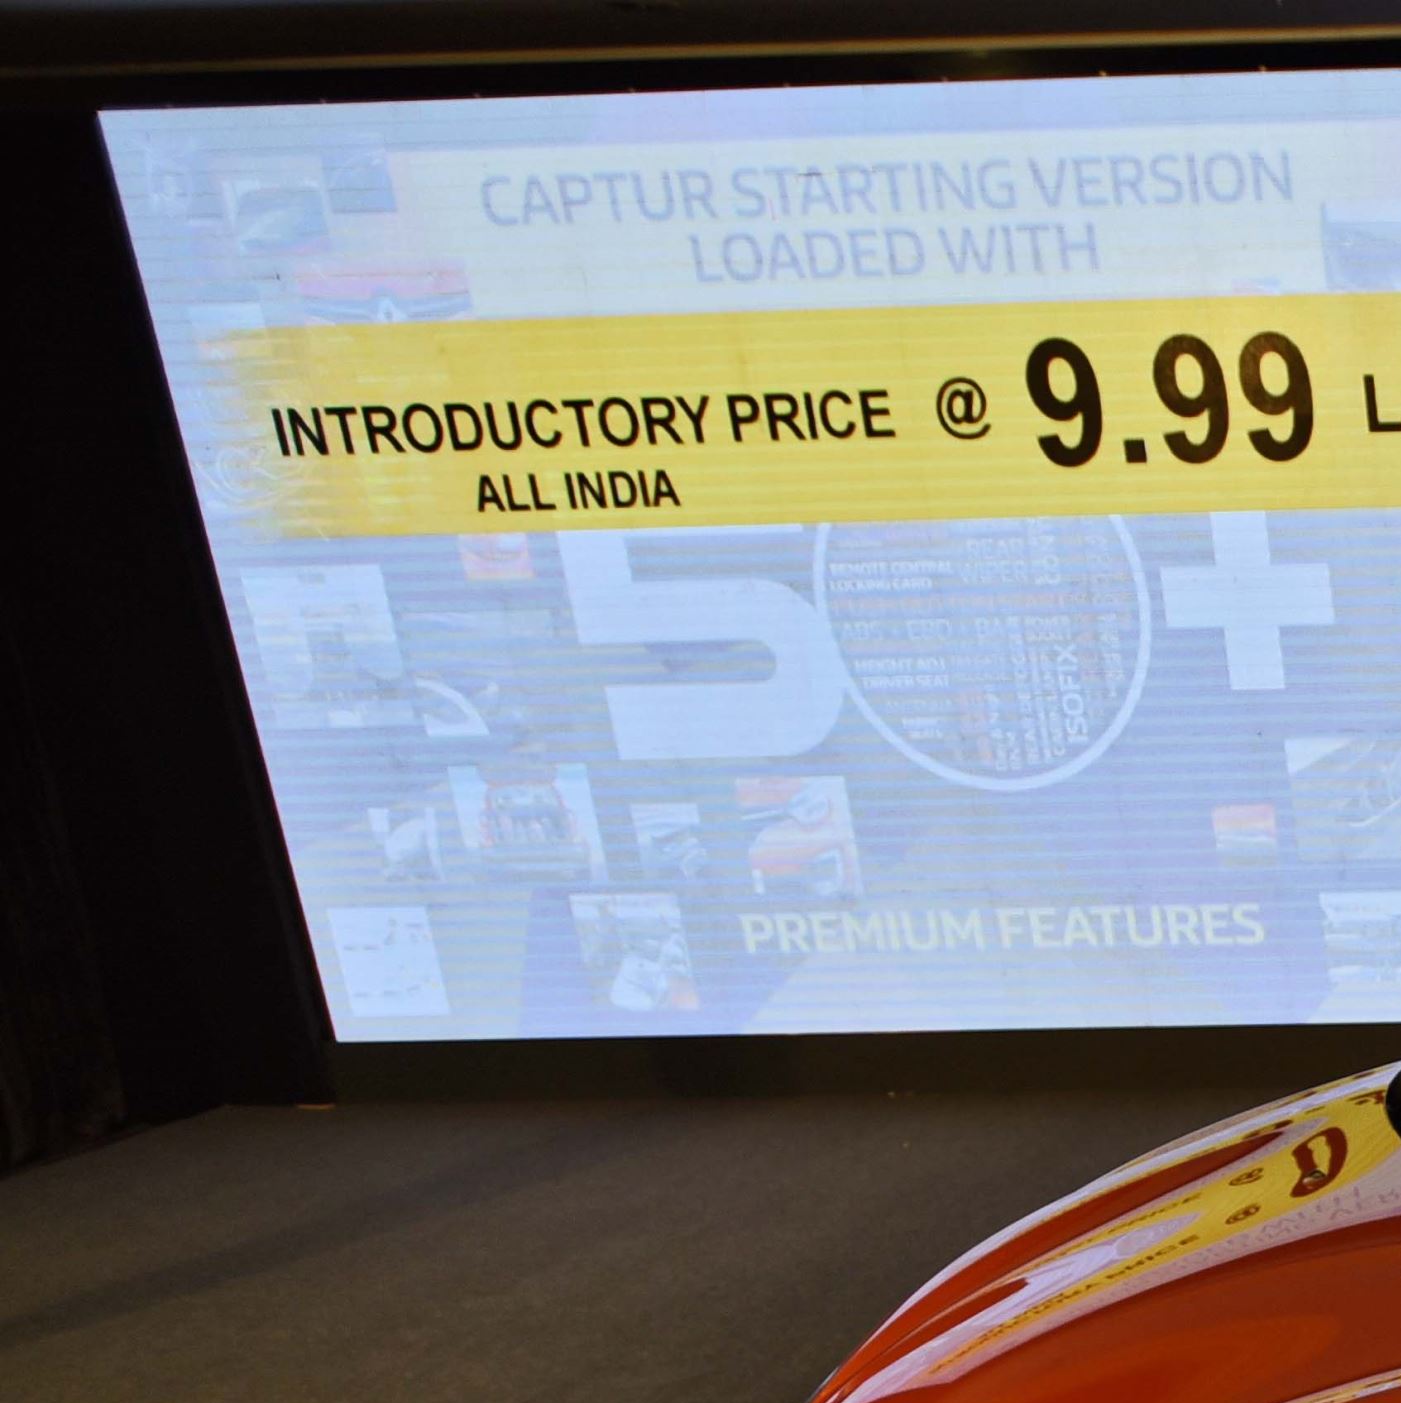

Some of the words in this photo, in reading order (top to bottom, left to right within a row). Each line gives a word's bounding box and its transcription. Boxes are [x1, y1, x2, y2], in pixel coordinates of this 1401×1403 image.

[480, 169, 719, 226] CAPTUR
[730, 158, 1017, 218] STARTING
[1027, 149, 1294, 208] VERSION
[688, 226, 926, 283] LOADED
[937, 222, 1100, 275] WITH
[271, 395, 709, 457] INTRODUCTORY
[726, 389, 896, 442] PRICE
[936, 377, 991, 440] @
[1025, 332, 1314, 468] 9.99
[478, 473, 557, 512] ALL
[564, 469, 681, 510] INDIA
[739, 909, 986, 955] PREMIUM
[998, 902, 1266, 949] FEATURES
